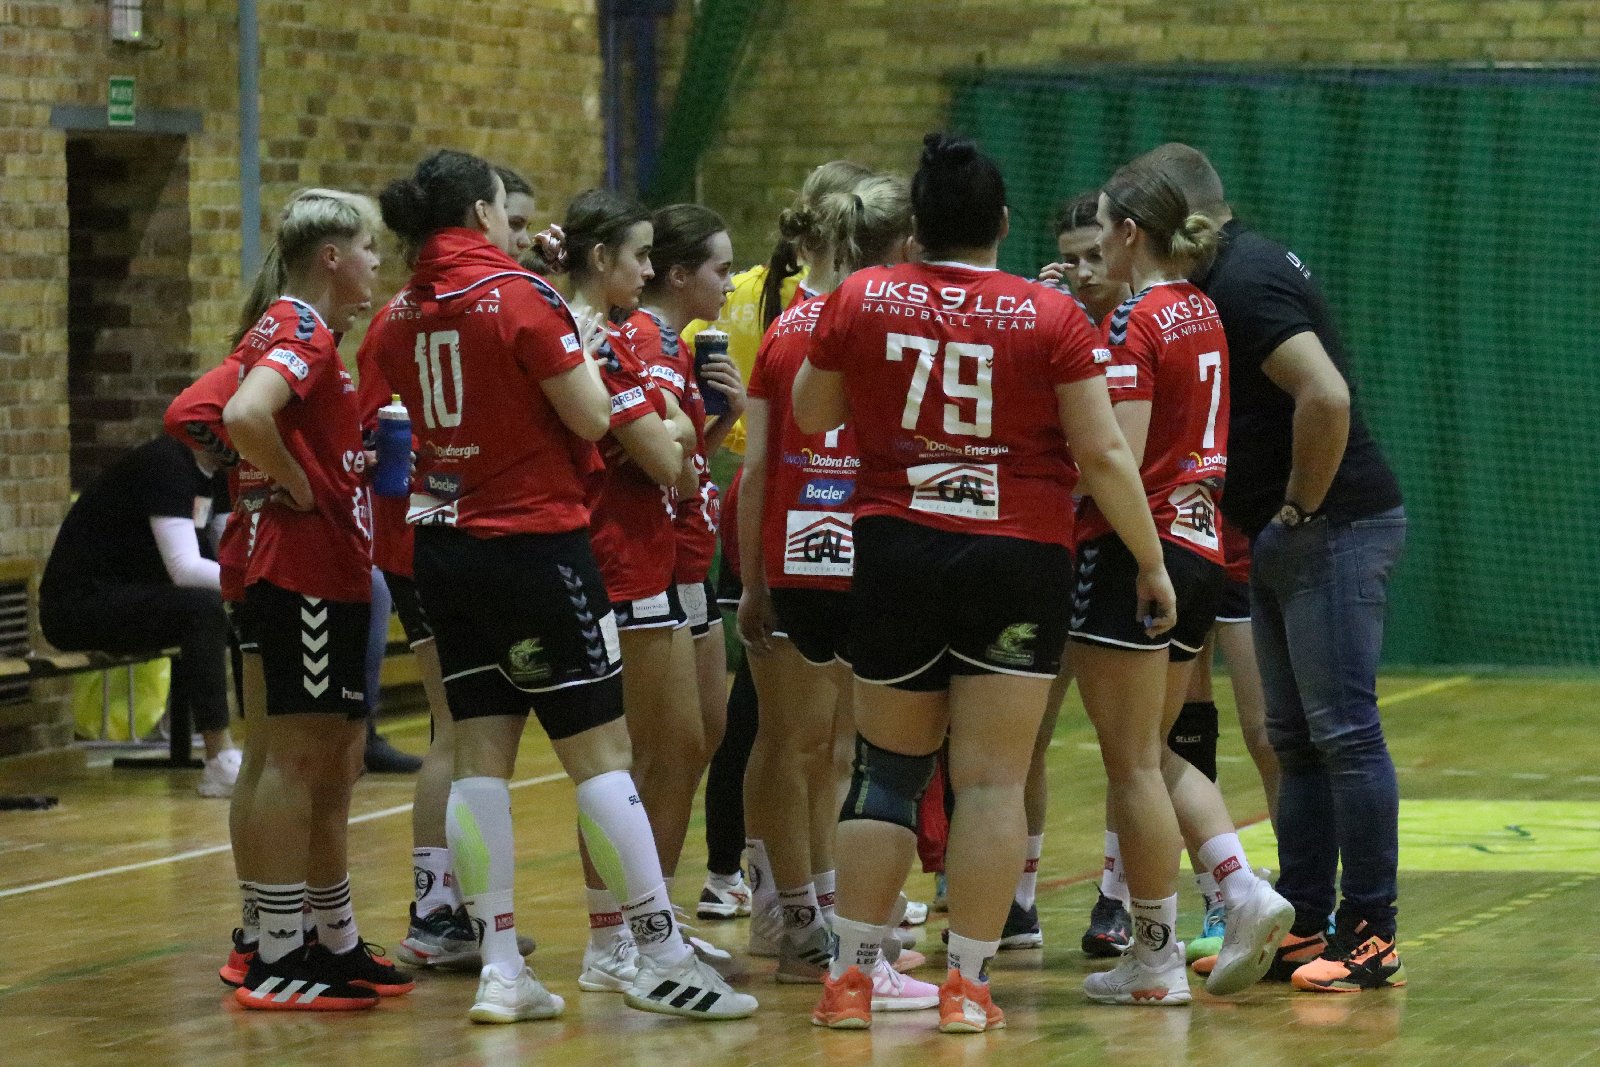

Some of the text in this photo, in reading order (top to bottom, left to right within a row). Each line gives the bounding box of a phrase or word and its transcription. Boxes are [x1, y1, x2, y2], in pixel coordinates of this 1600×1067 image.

[865, 279, 1037, 315] UKS 9 LCA
[777, 301, 825, 327] UKS
[862, 302, 1036, 330] HANDBALL TEAM
[1152, 301, 1192, 329] UKS
[1188, 294, 1203, 317] 9
[1163, 322, 1213, 345] HANDBALL
[271, 349, 307, 376] JAREXS
[414, 329, 463, 429] 10
[885, 331, 995, 439] 79
[611, 387, 642, 409] AREXS
[1198, 351, 1222, 449] 7
[812, 453, 843, 468] Dobra
[963, 444, 1009, 457] Energia
[1175, 735, 1201, 744] SELECT
